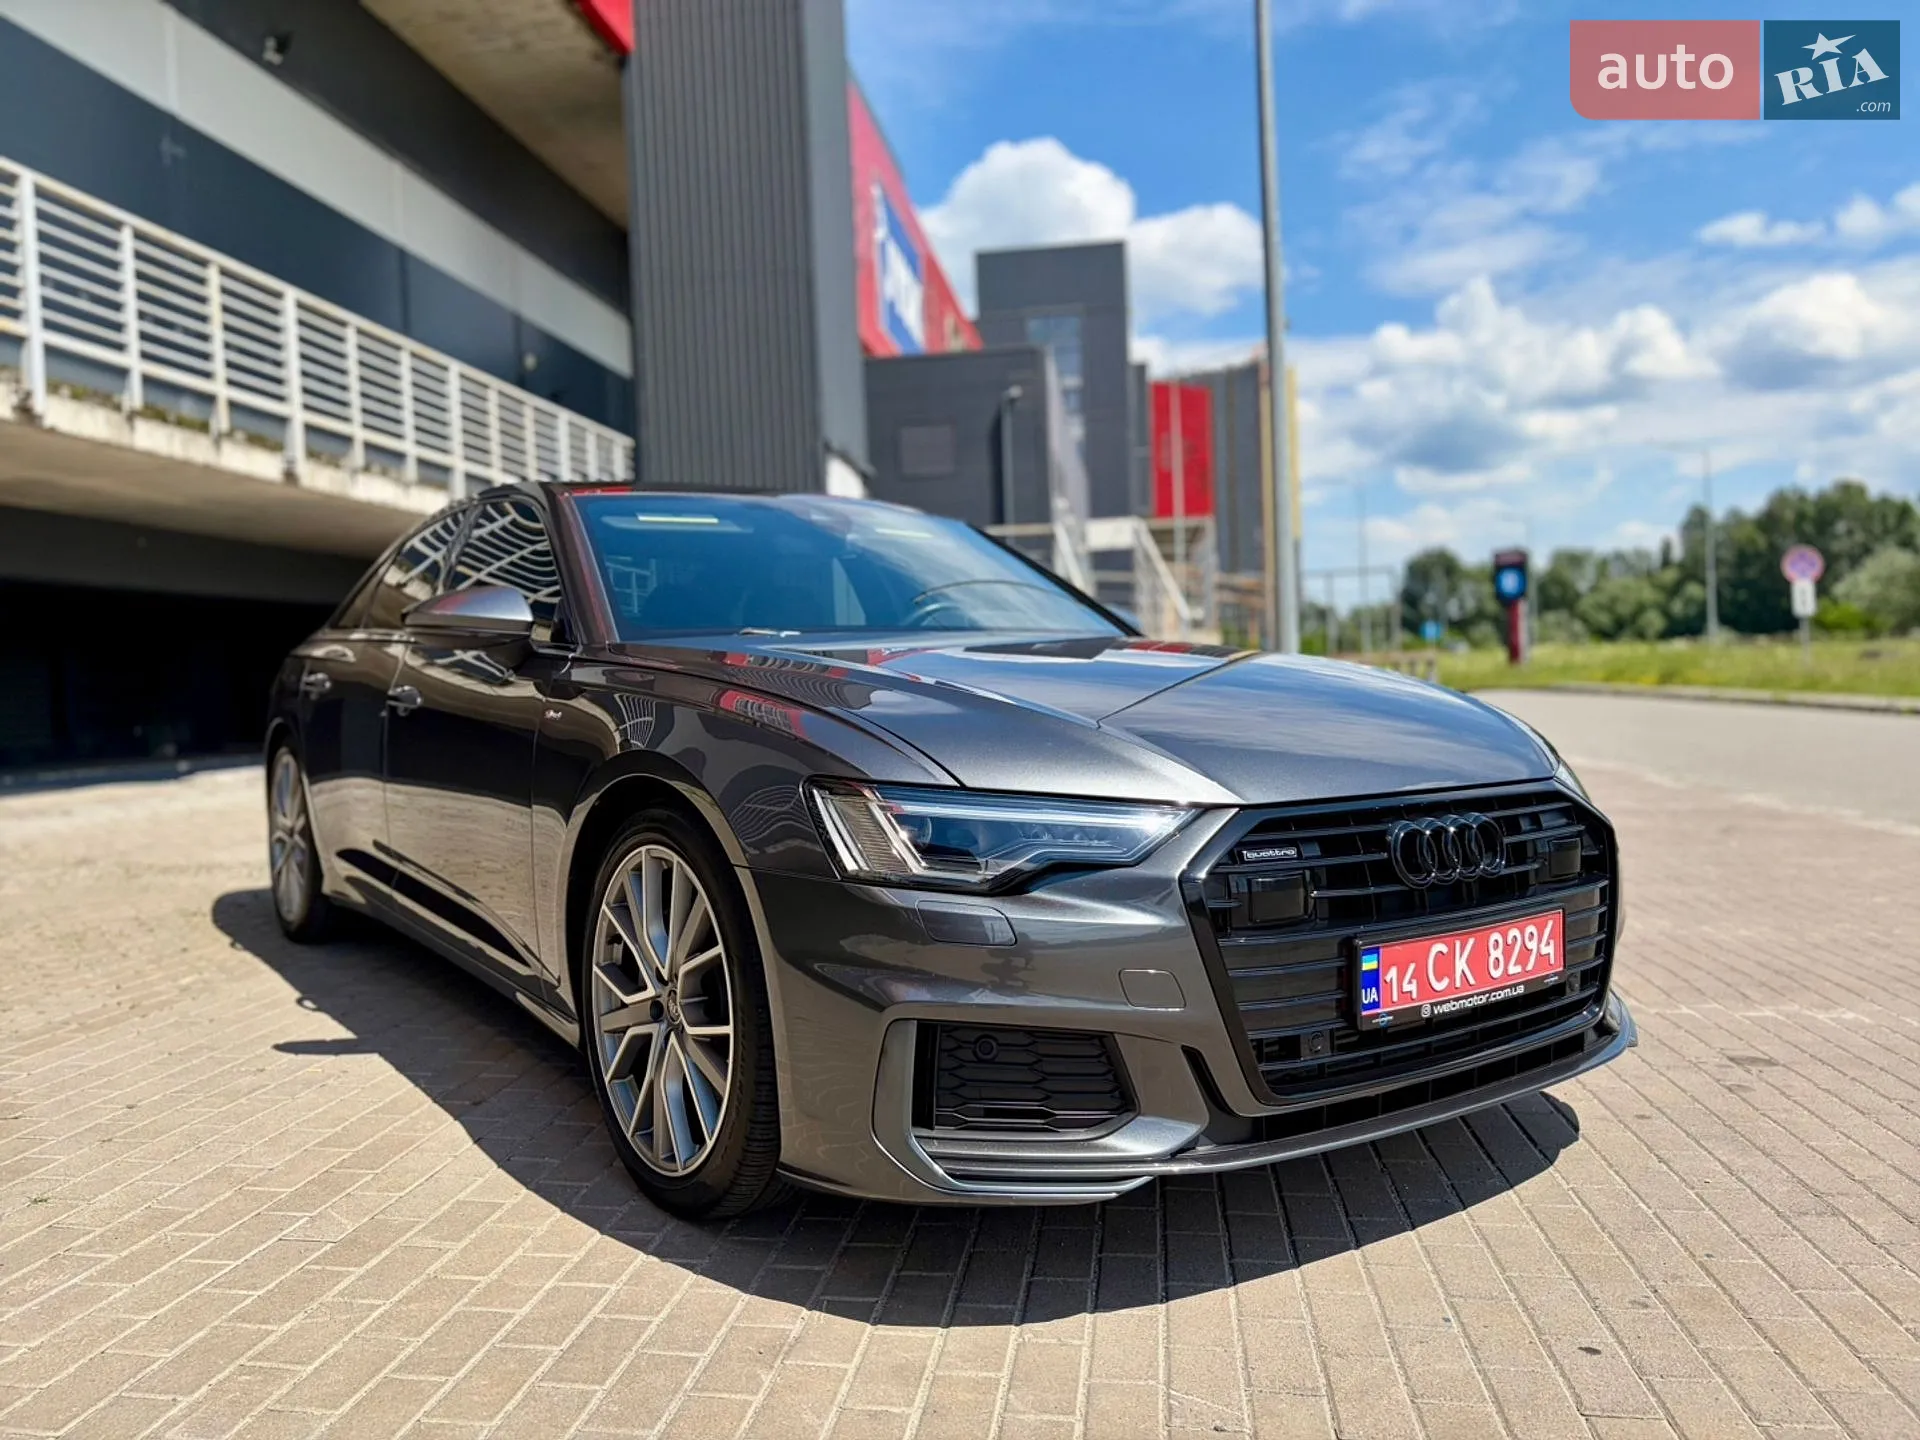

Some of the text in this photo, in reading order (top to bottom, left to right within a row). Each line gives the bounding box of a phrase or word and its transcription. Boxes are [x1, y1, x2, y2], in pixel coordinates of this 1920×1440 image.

[1246, 849, 1295, 859] quattro
[1383, 919, 1555, 1003] 14 CK 8294
[1362, 990, 1379, 1005] UA
